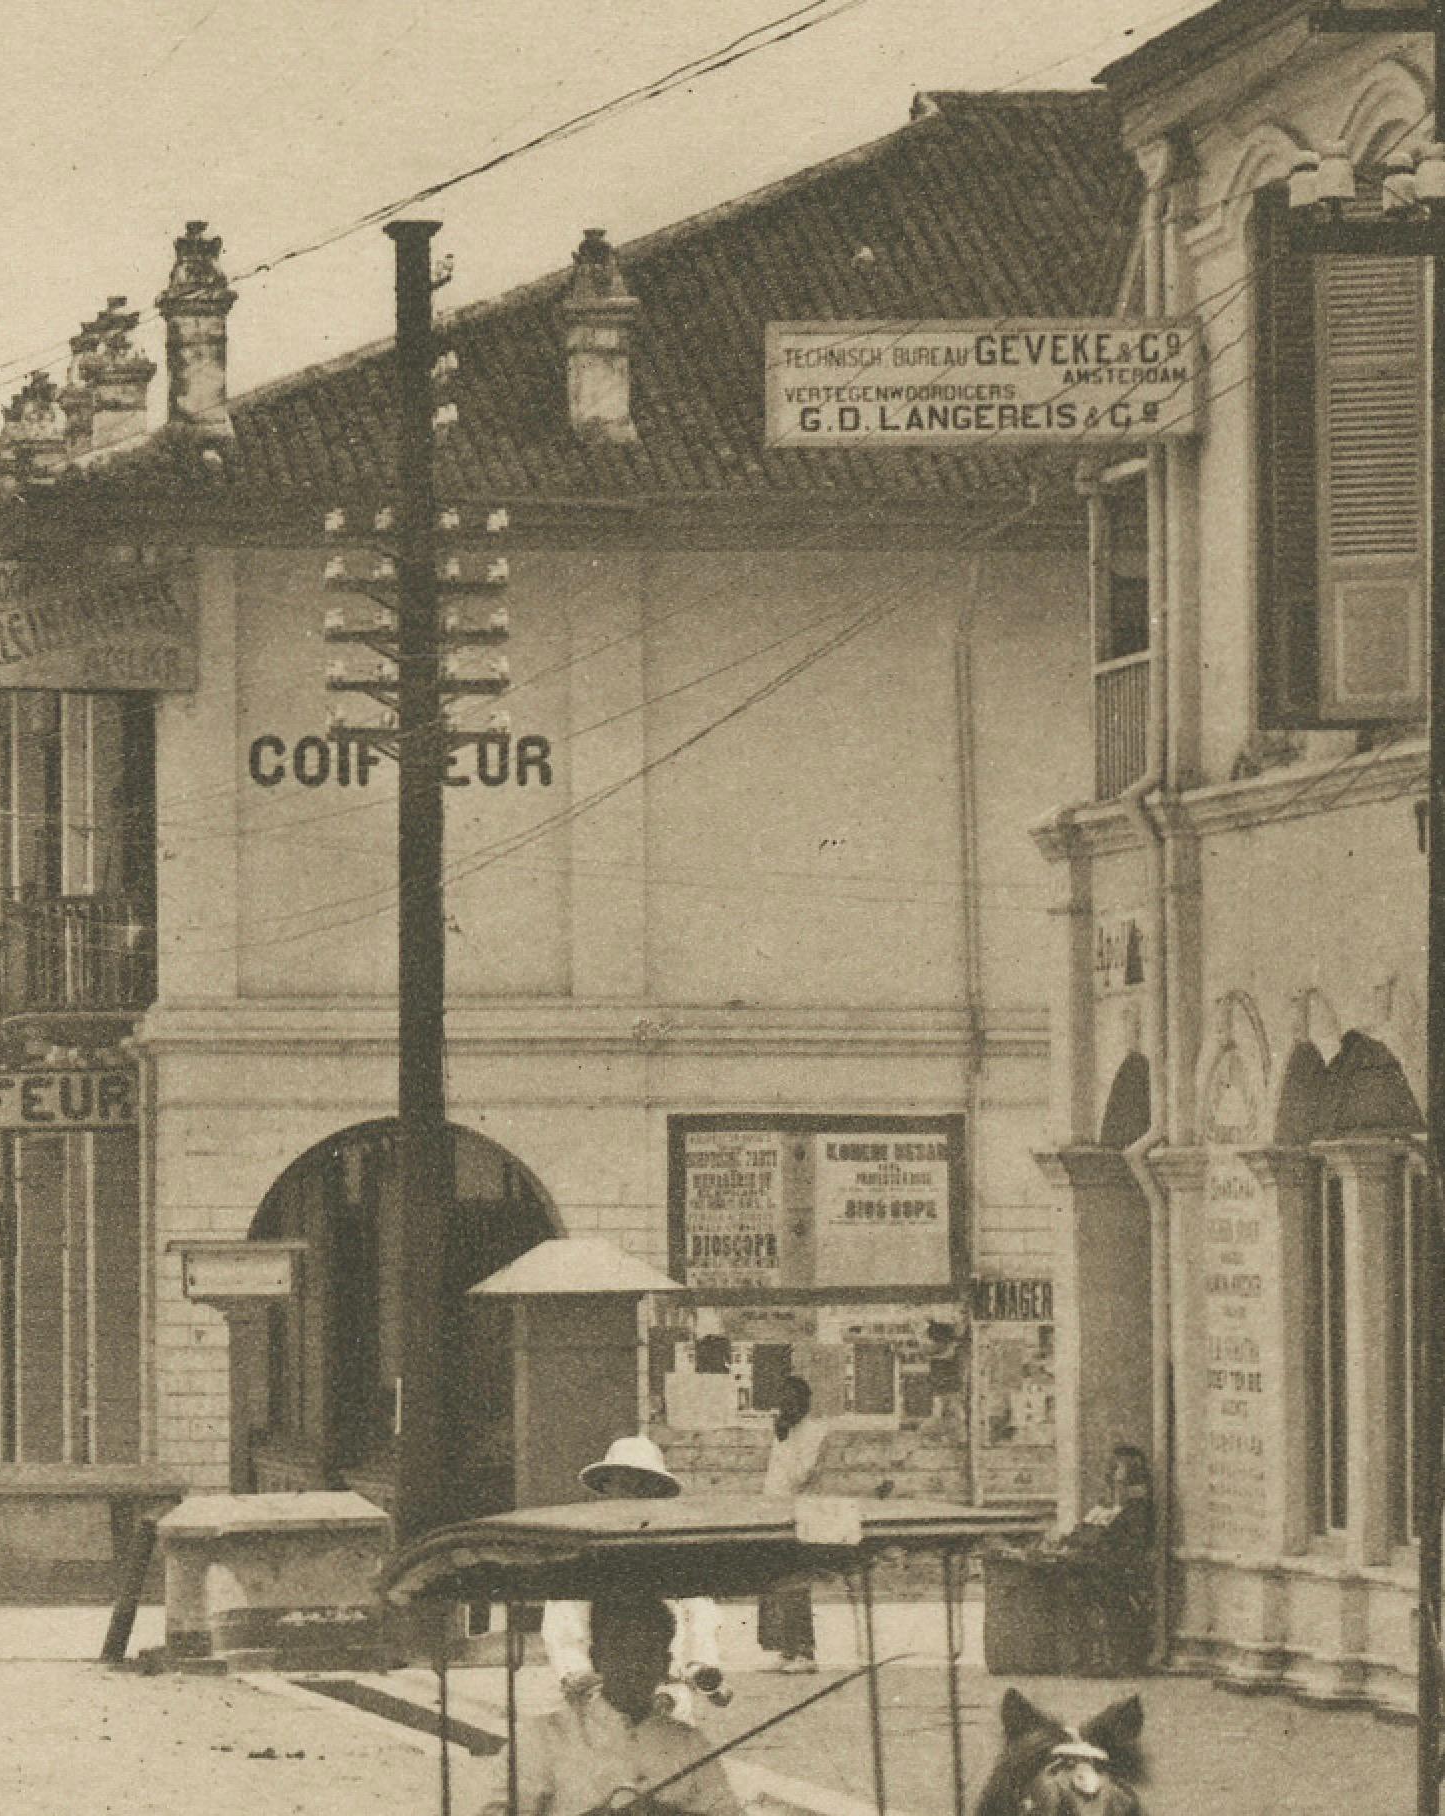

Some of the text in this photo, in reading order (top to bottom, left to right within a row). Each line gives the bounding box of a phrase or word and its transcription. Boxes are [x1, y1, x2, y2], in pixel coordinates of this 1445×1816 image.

[784, 347, 882, 368] TECHNISCH
[893, 347, 968, 367] BUREAU
[1063, 368, 1186, 384] AMSTERDAM
[785, 384, 1016, 402] VERTEGENWOORDIGERS
[879, 404, 1076, 431] LANGEREIS
[249, 735, 552, 787] COIFEUR
